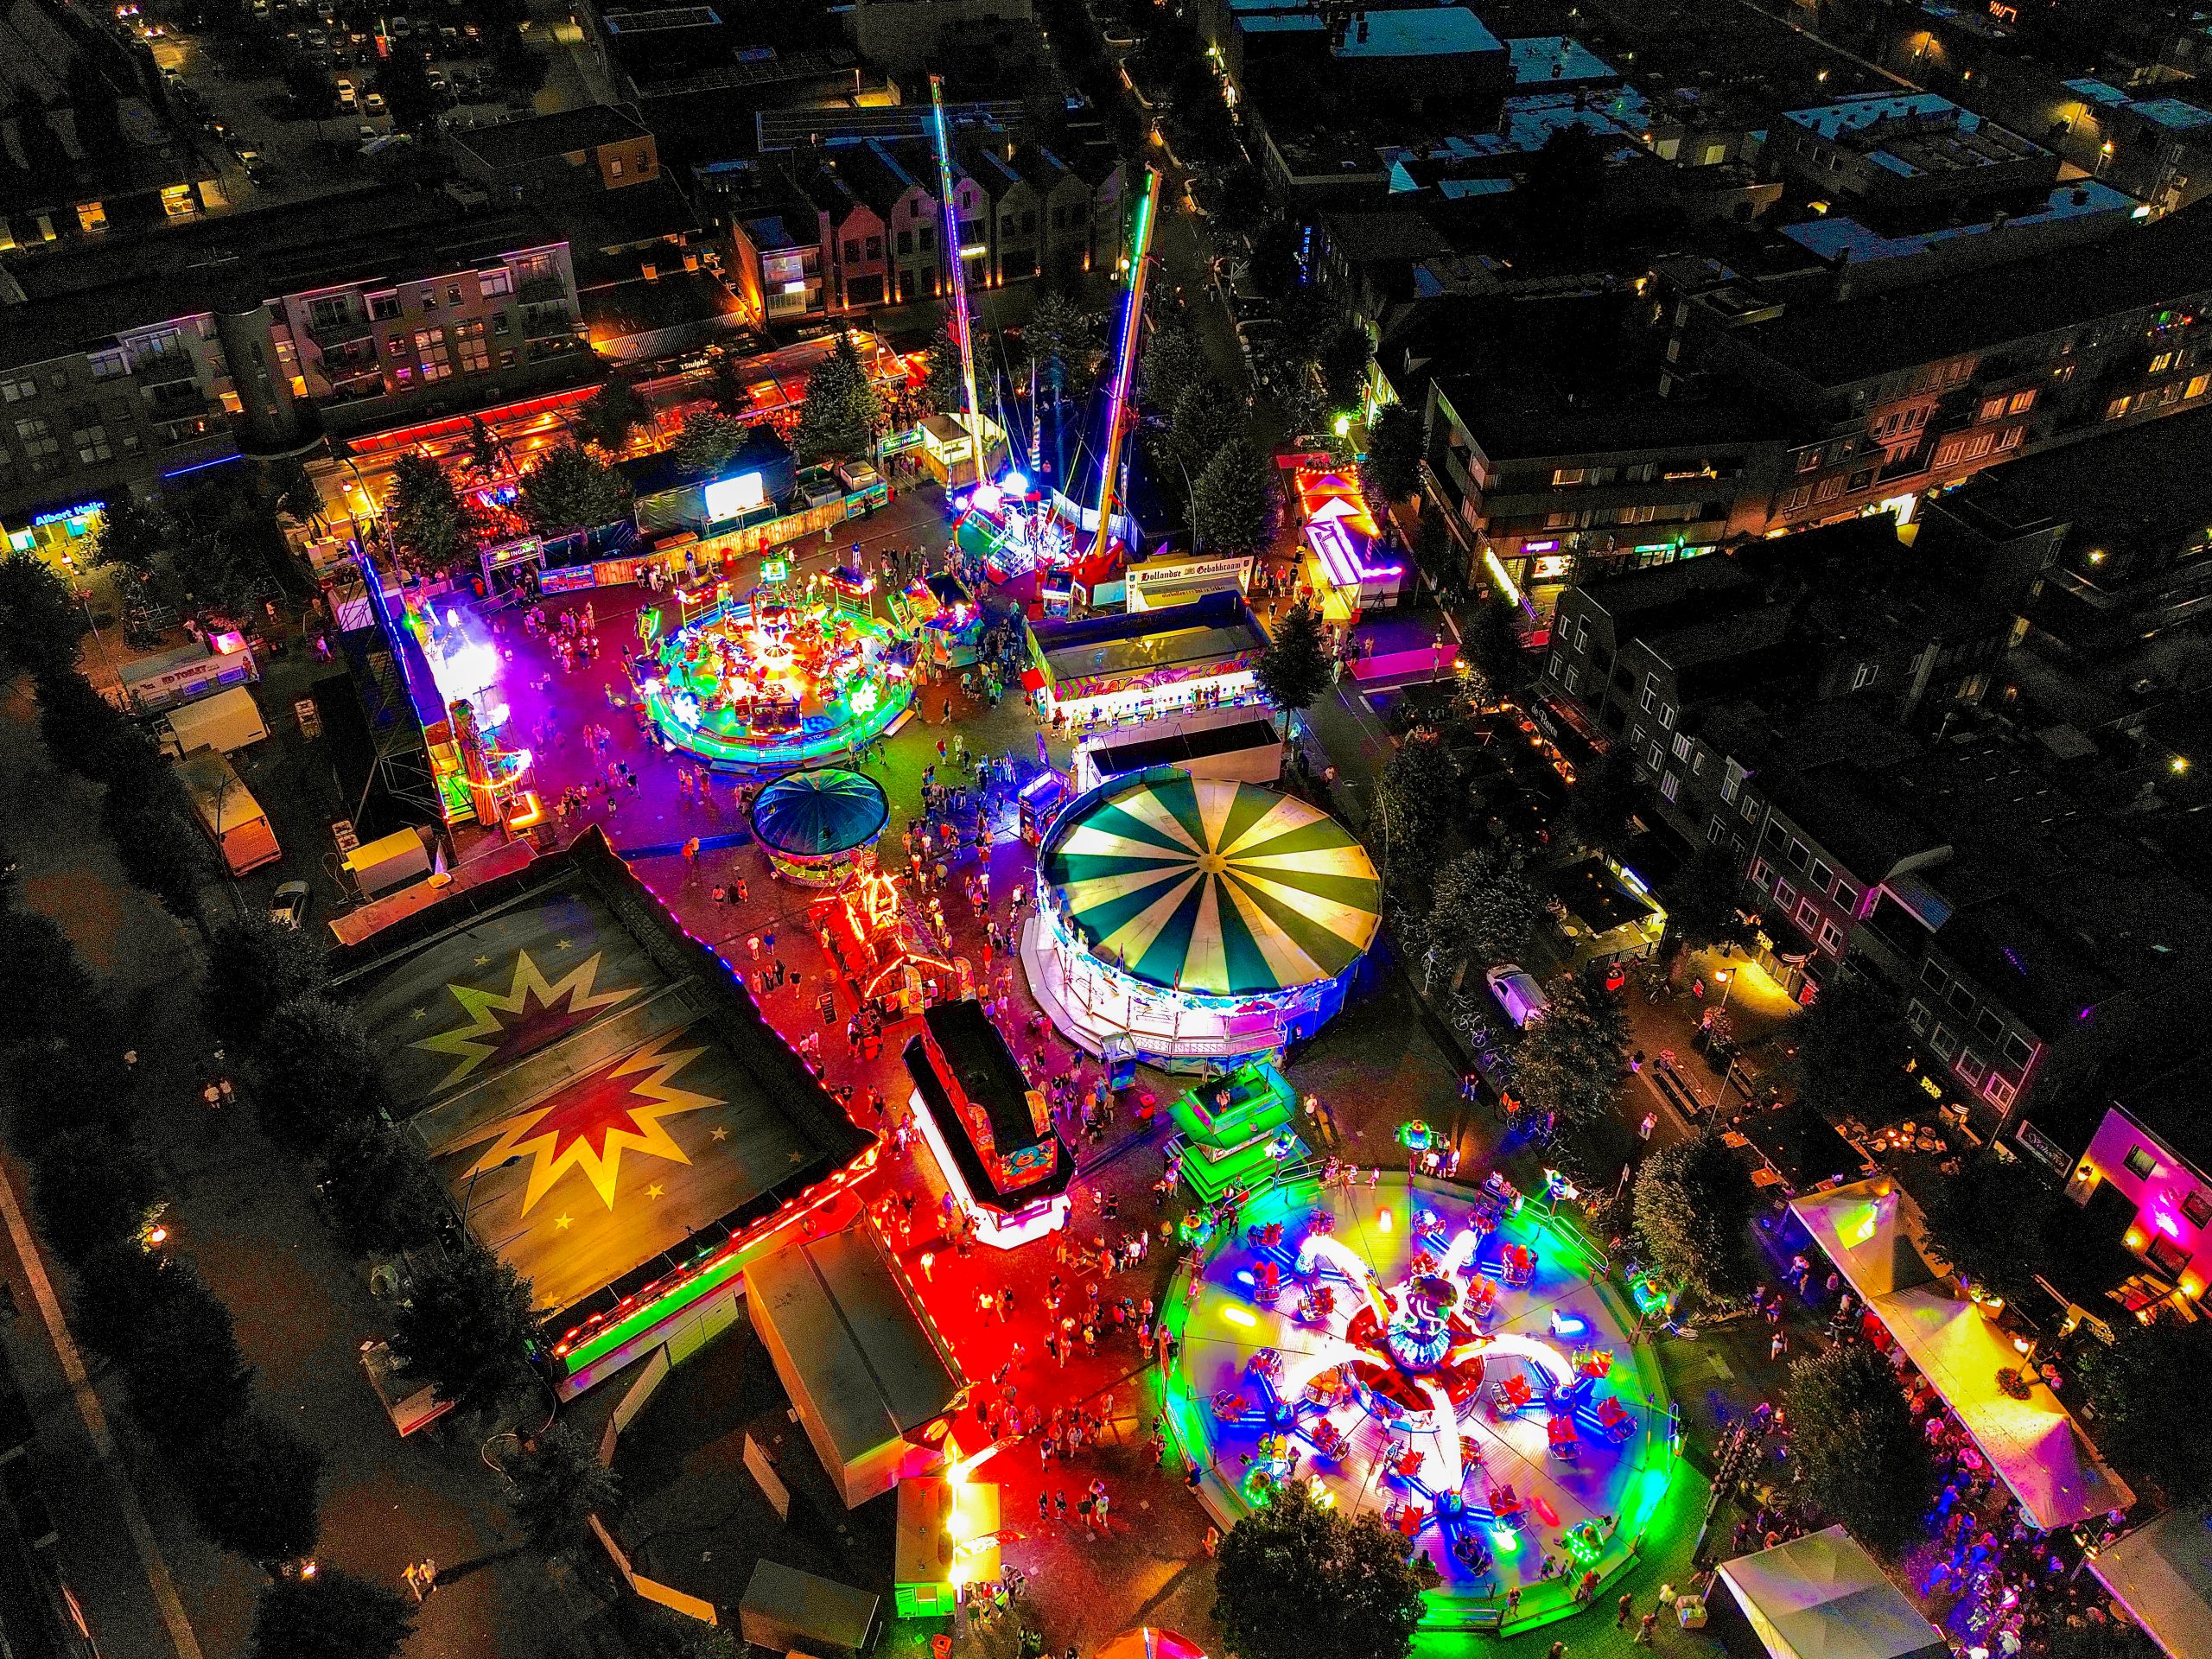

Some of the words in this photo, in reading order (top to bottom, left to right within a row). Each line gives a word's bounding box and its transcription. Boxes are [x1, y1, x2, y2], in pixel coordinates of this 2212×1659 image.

[35, 509, 73, 526] Albert
[511, 545, 536, 557] INGANG
[1141, 570, 1181, 582] Hollandse
[1081, 677, 1133, 697] PLAY
[1198, 658, 1251, 678] TOWN
[698, 728, 723, 740] DANGER
[807, 732, 826, 741] STOP
